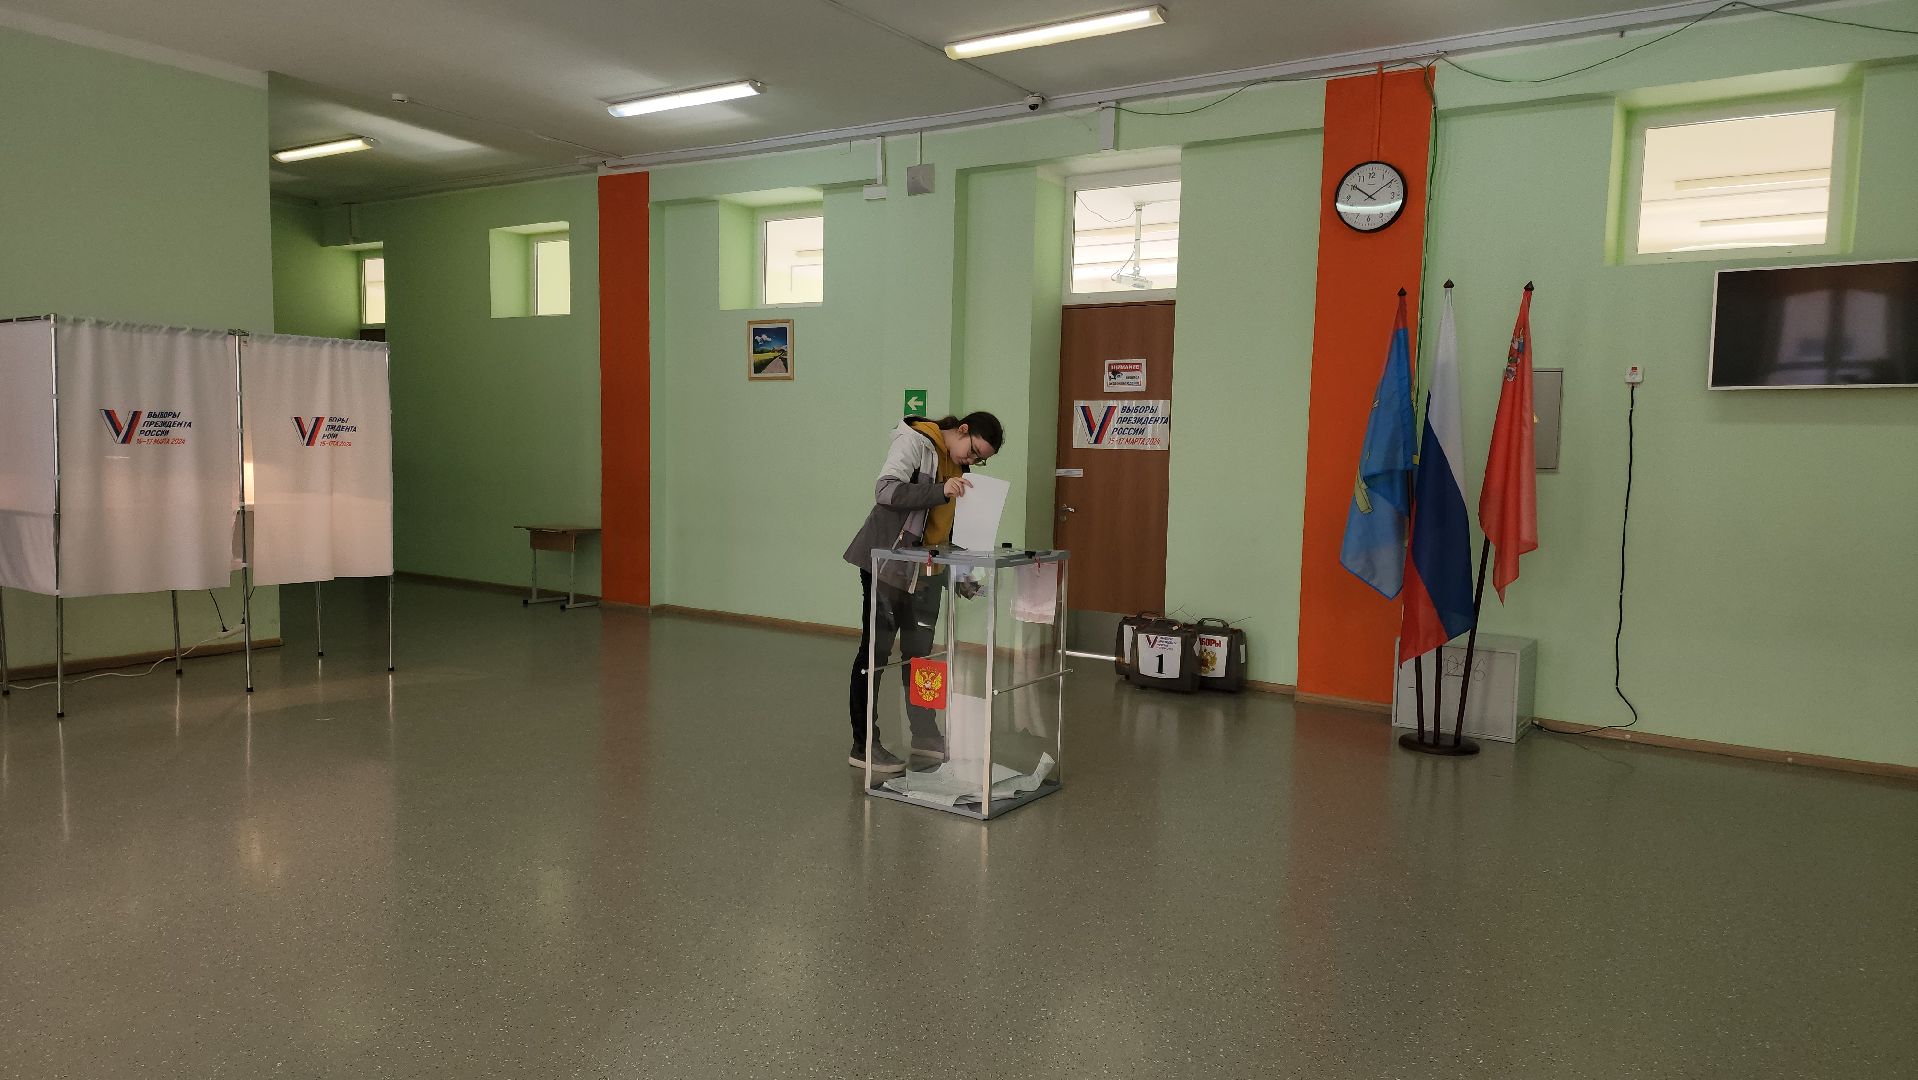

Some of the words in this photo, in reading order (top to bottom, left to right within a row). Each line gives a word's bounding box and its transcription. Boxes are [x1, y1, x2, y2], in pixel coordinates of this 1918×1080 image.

[1120, 405, 1159, 414] ВЫБОРЫ
[146, 411, 181, 419] ВЫБОРЫ
[1115, 416, 1169, 426] ПРЕЗИДЕНТА
[139, 429, 170, 437] РОССИИ
[1111, 427, 1146, 436] РОССИИ
[1124, 437, 1145, 446] МАРТА
[1155, 654, 1166, 675] 1
